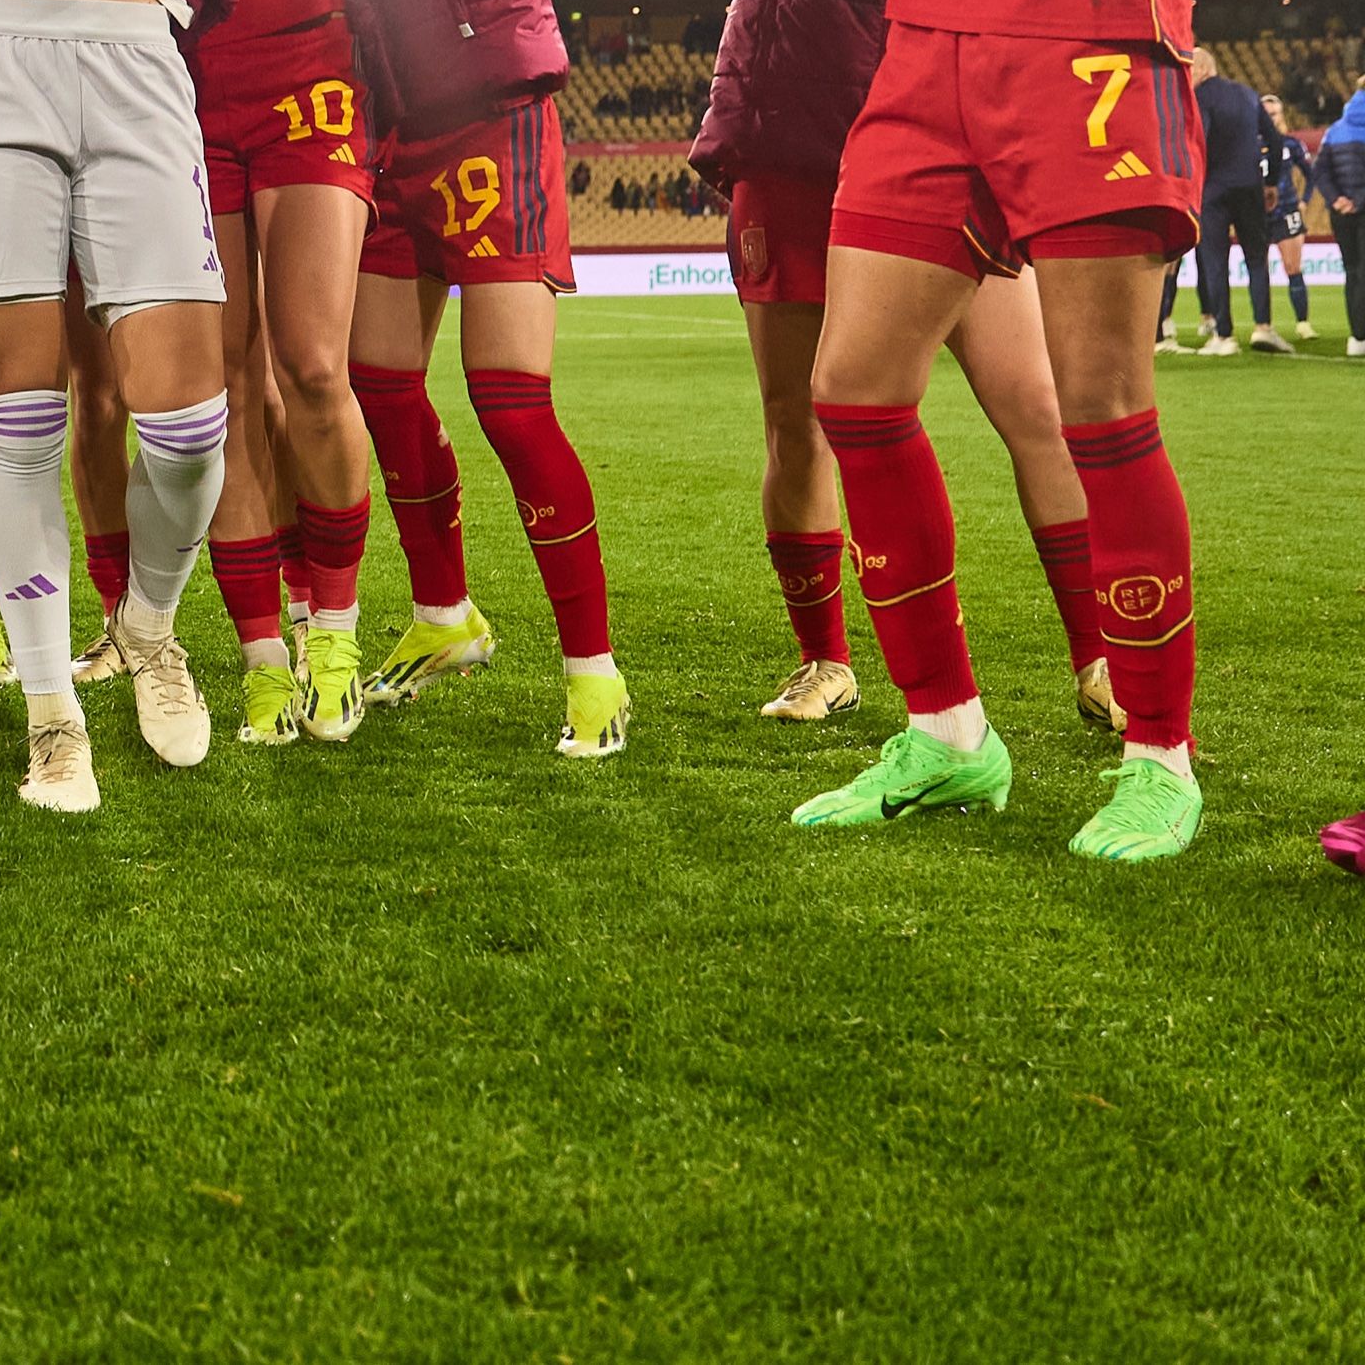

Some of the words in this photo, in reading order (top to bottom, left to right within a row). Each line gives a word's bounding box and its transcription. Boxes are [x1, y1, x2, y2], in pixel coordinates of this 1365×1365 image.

[273, 80, 355, 141] 10
[1072, 53, 1132, 147] 7
[431, 156, 500, 237] 19
